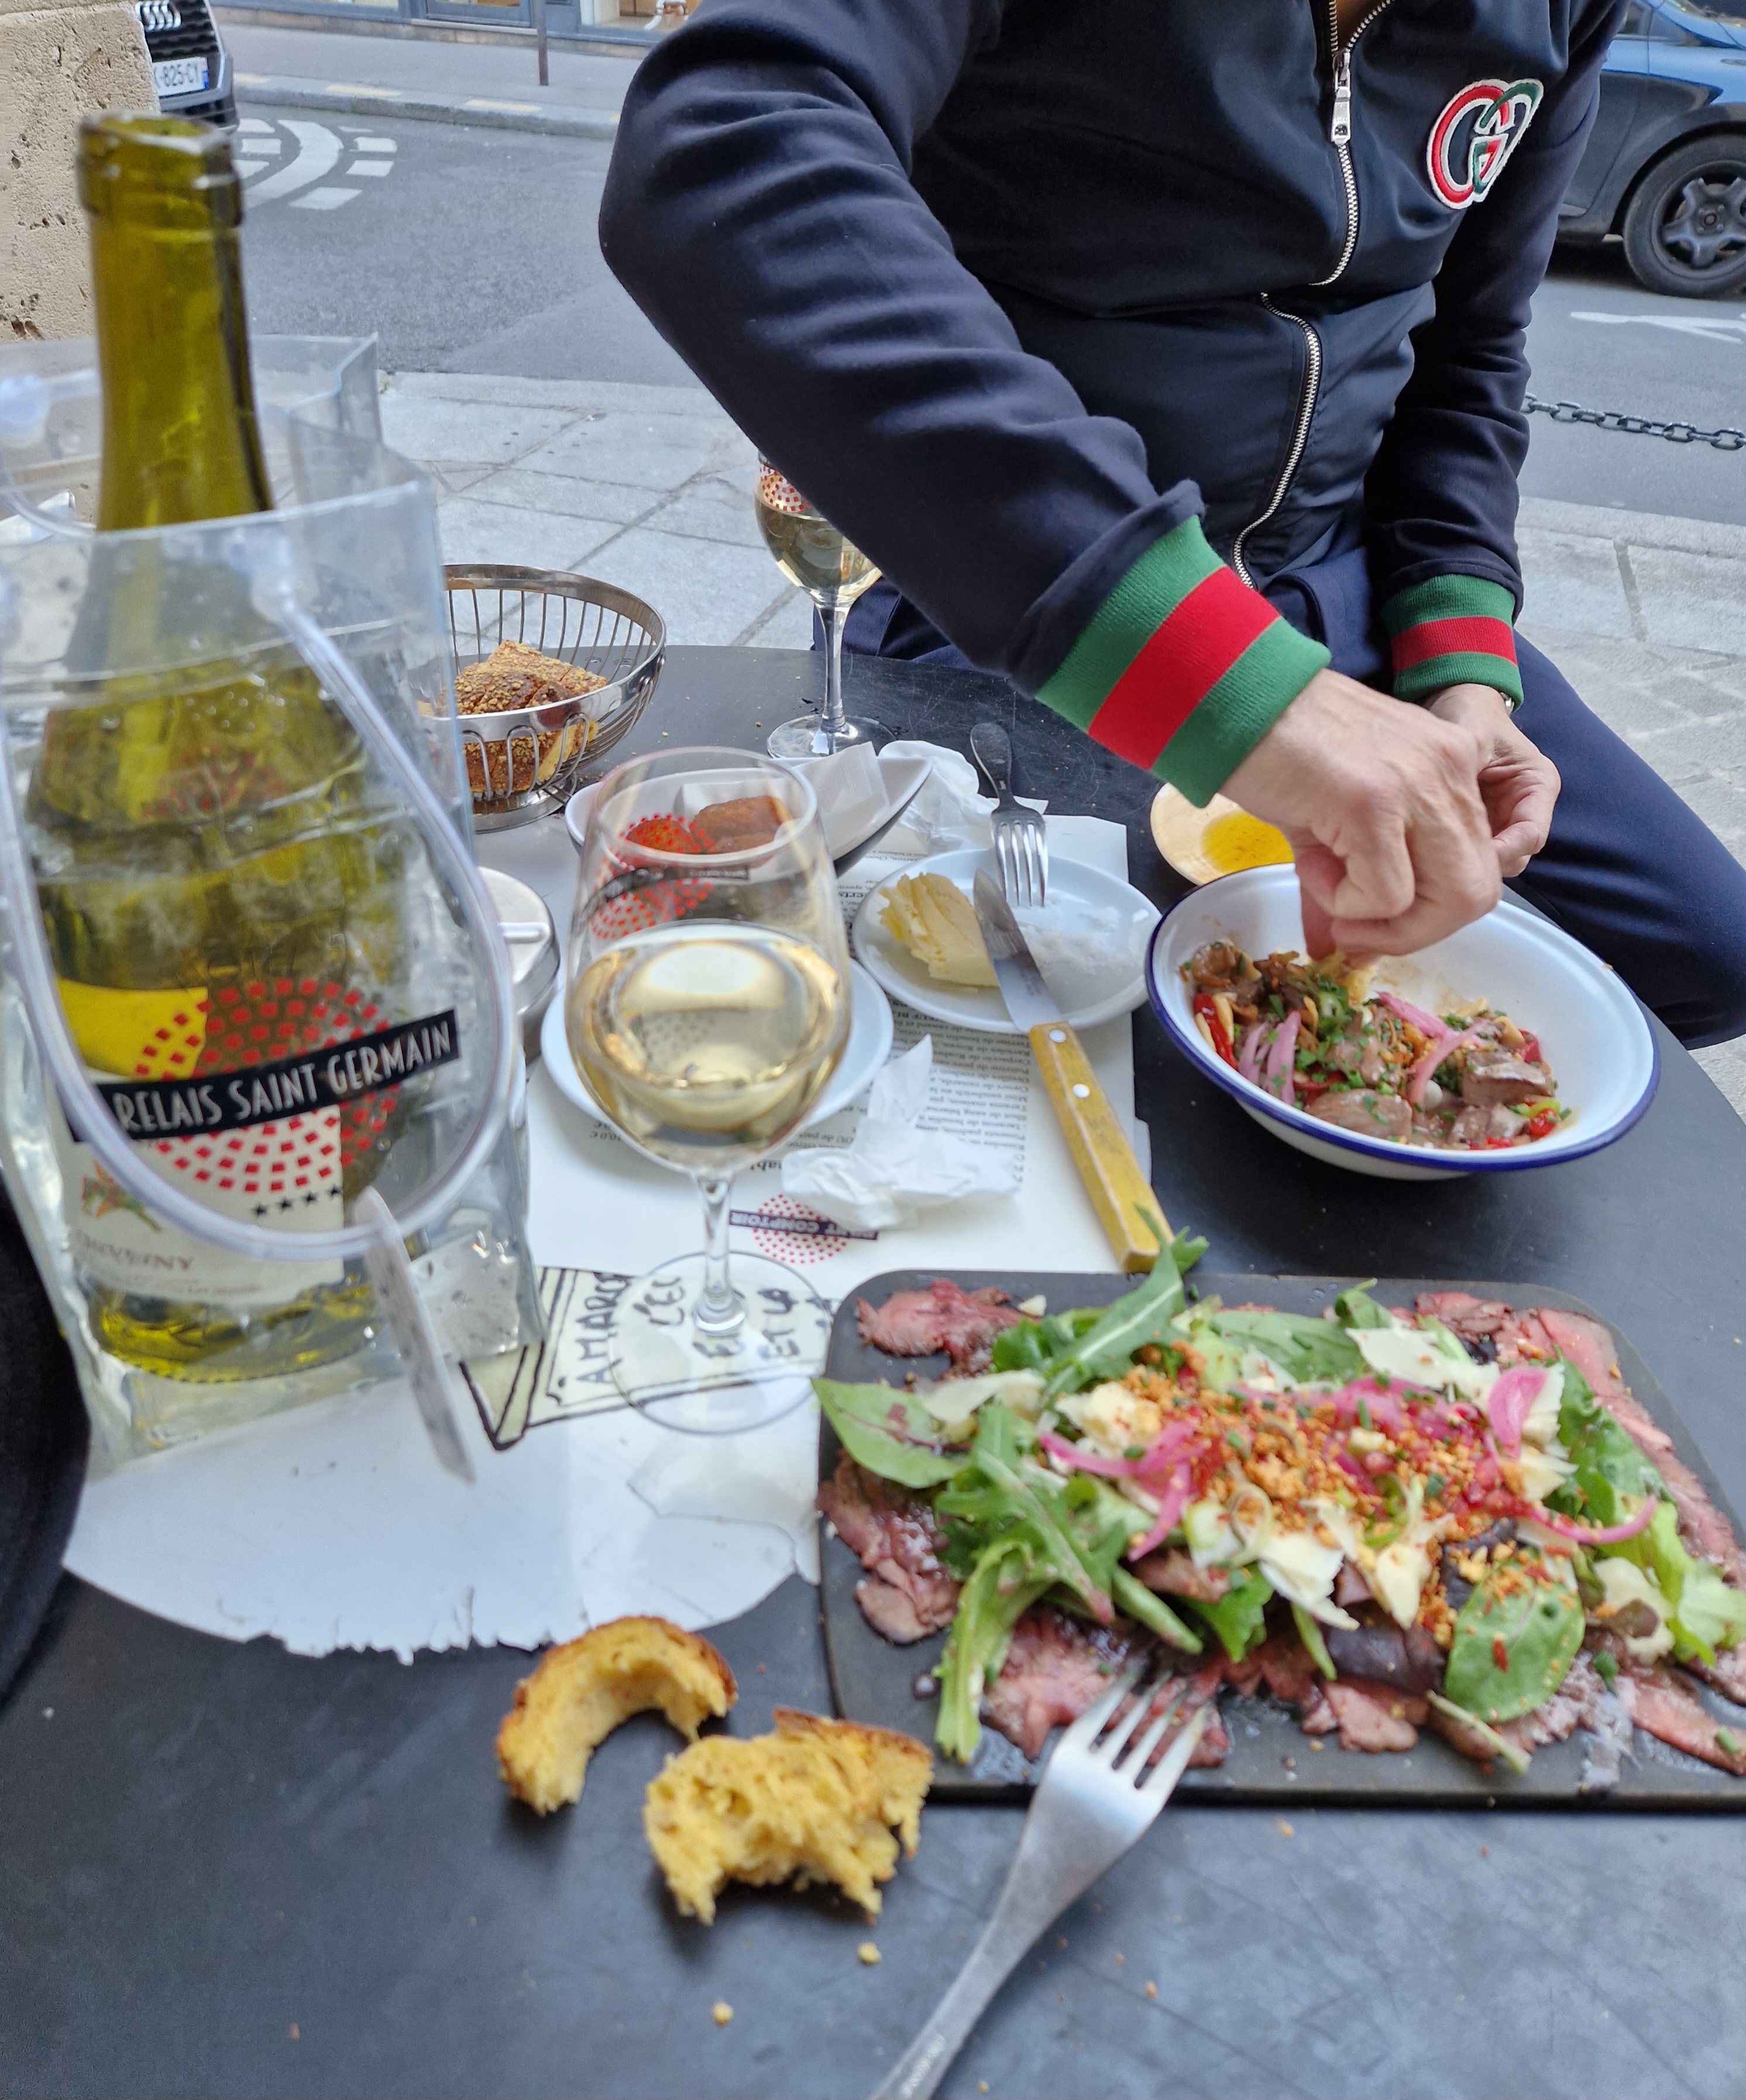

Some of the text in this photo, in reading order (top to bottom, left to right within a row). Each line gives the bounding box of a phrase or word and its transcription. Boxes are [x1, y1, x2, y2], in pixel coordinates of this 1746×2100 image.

[113, 1020, 451, 1132] RELAIS SAINT GERMAIN
